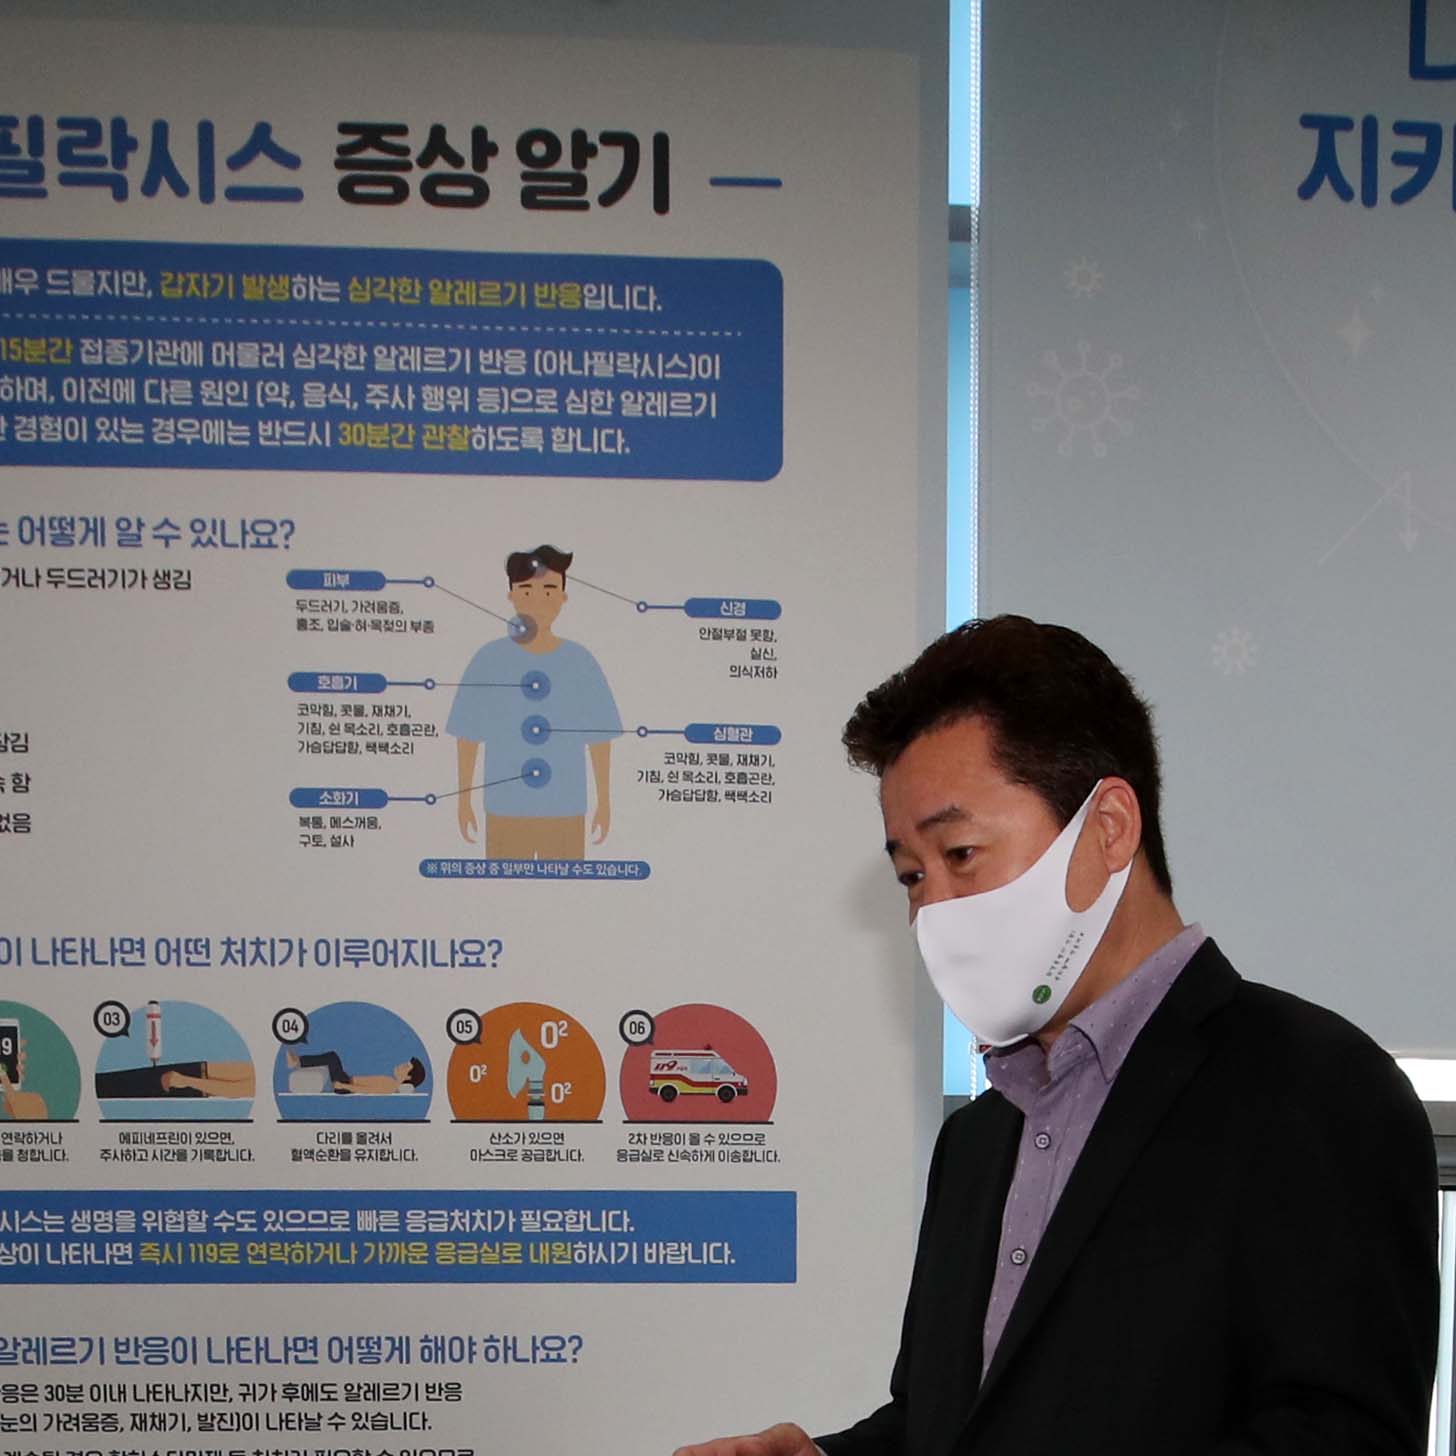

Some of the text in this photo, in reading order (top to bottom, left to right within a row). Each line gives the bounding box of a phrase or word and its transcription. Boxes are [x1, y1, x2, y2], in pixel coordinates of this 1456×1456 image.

[332, 121, 500, 208] 증상
[514, 128, 670, 212] 알기
[45, 268, 153, 297] 드물지만,
[159, 271, 235, 299] 갑자기
[240, 273, 341, 302] 발생하는
[346, 276, 423, 304] 심각한
[427, 278, 526, 306] 알레르기
[532, 281, 663, 311] 반응입니다.
[79, 338, 204, 366] 접종기관에
[210, 340, 285, 368] 머물러
[291, 342, 368, 370] 심각한
[372, 344, 471, 373] 알레르기
[478, 348, 528, 375] 반응
[16, 515, 106, 547] 어떻게
[114, 516, 146, 548] 알
[151, 516, 182, 548] 수
[188, 517, 296, 549] 있나요?
[45, 567, 148, 589] 두드러기가
[151, 568, 192, 591] 생김
[729, 664, 778, 679] 의식저하
[10, 771, 32, 794] 함
[30, 936, 146, 967] 나타나면
[154, 937, 212, 967] 어떤
[219, 936, 308, 967] 처치가
[313, 938, 503, 968] 이루어지나요?
[103, 1011, 120, 1027] 03
[281, 1019, 300, 1034] 04
[456, 1019, 473, 1034] 05
[629, 1019, 646, 1035] 06
[489, 1131, 564, 1145] 산소가 있으면
[69, 1209, 136, 1233] 생명을
[140, 1208, 209, 1233] 위협할
[212, 1209, 258, 1233] 수도
[262, 1209, 351, 1232] 있으므로
[356, 1209, 400, 1232] 빠른
[404, 1208, 516, 1233] 응급처치가
[519, 1209, 635, 1233] 필요합니다.
[45, 1242, 134, 1265] 나타나면
[138, 1241, 182, 1265] 즉시
[188, 1242, 241, 1264] 119로
[245, 1241, 358, 1264] 연락하거나
[362, 1241, 430, 1264] 가까운
[434, 1241, 523, 1264] 응급실로
[528, 1241, 638, 1264] 내원하시기
[643, 1241, 736, 1264] 바랍니다.
[113, 1335, 198, 1366] 반응이
[206, 1335, 319, 1365] 나타나면
[326, 1335, 411, 1365] 어떻게
[418, 1334, 477, 1364] 해야
[482, 1334, 583, 1364] 하나요?
[43, 1383, 84, 1403] 30분
[88, 1383, 127, 1403] 이내
[132, 1382, 233, 1403] 나타나지만,
[237, 1382, 278, 1403] 귀가
[280, 1382, 339, 1402] 후에도
[342, 1382, 419, 1402] 알레르기
[424, 1381, 463, 1402] 반응
